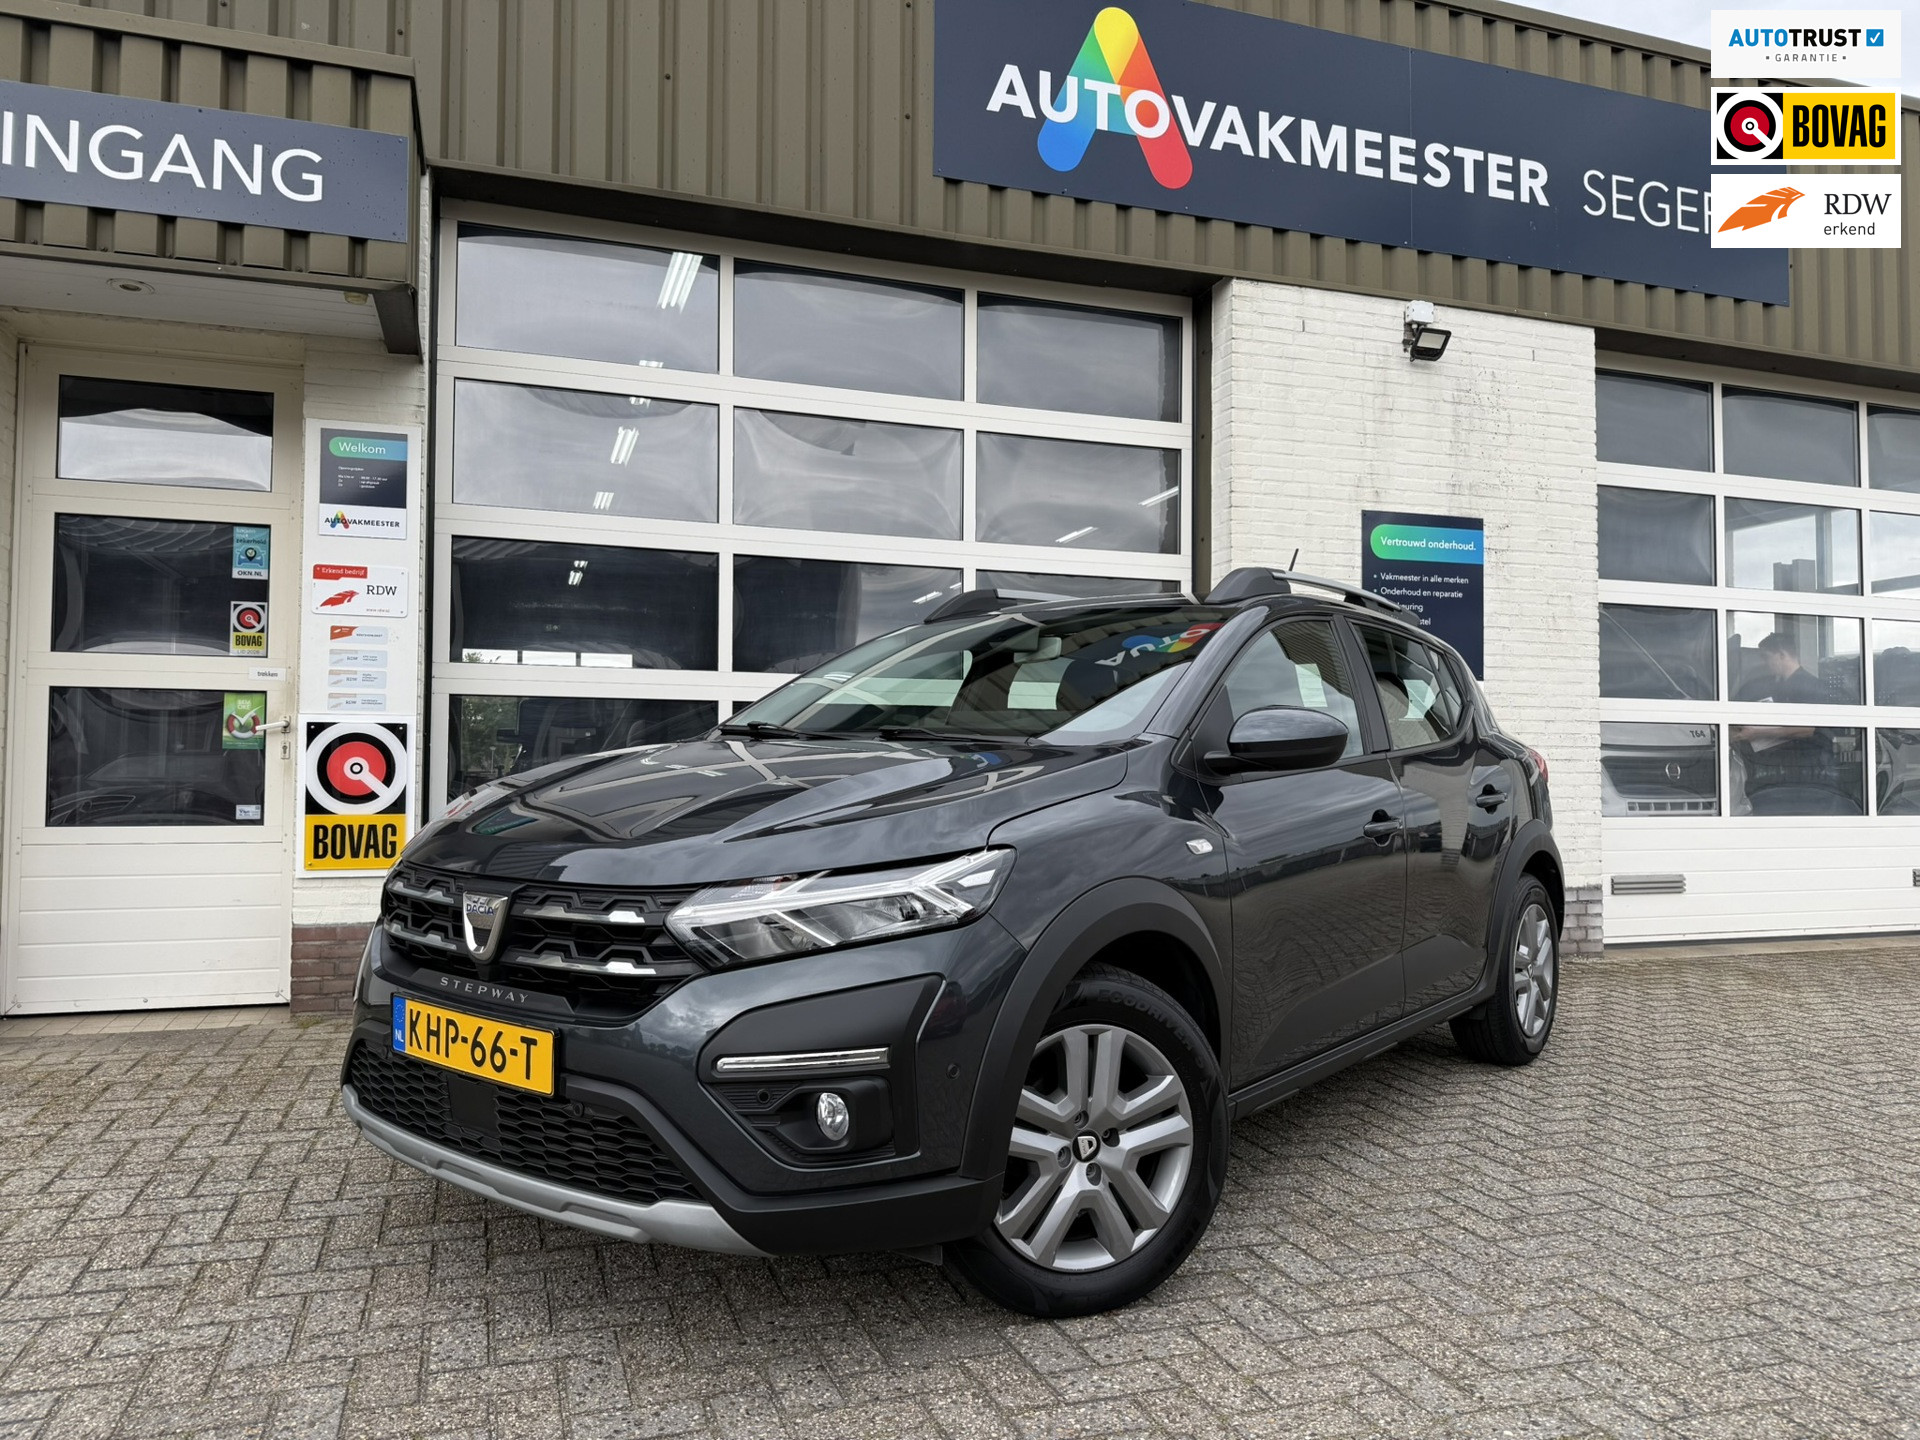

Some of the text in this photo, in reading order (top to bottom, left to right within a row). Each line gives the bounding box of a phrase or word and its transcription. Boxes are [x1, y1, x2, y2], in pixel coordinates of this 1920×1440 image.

[986, 64, 1711, 235] AUTOVAKMEESTER SEGE
[1, 111, 324, 203] INGANG
[338, 441, 386, 455] Welkom
[324, 517, 400, 528] AUTOVAKMEESTER
[1380, 536, 1476, 551] Vertrouwd onderhoud.
[344, 568, 365, 576] bedrijf
[1380, 572, 1469, 584] Vakmeester in alle merken
[366, 584, 397, 596] RDW
[1380, 586, 1421, 596] Onderhoud
[1432, 590, 1463, 599] reparatie
[235, 634, 263, 647] BOVAG
[313, 823, 397, 860] BOVAG
[466, 903, 495, 916] DACIA
[440, 976, 530, 1004] STEPWAY
[395, 1028, 404, 1043] NL
[410, 1008, 538, 1080] KHP-66-T
